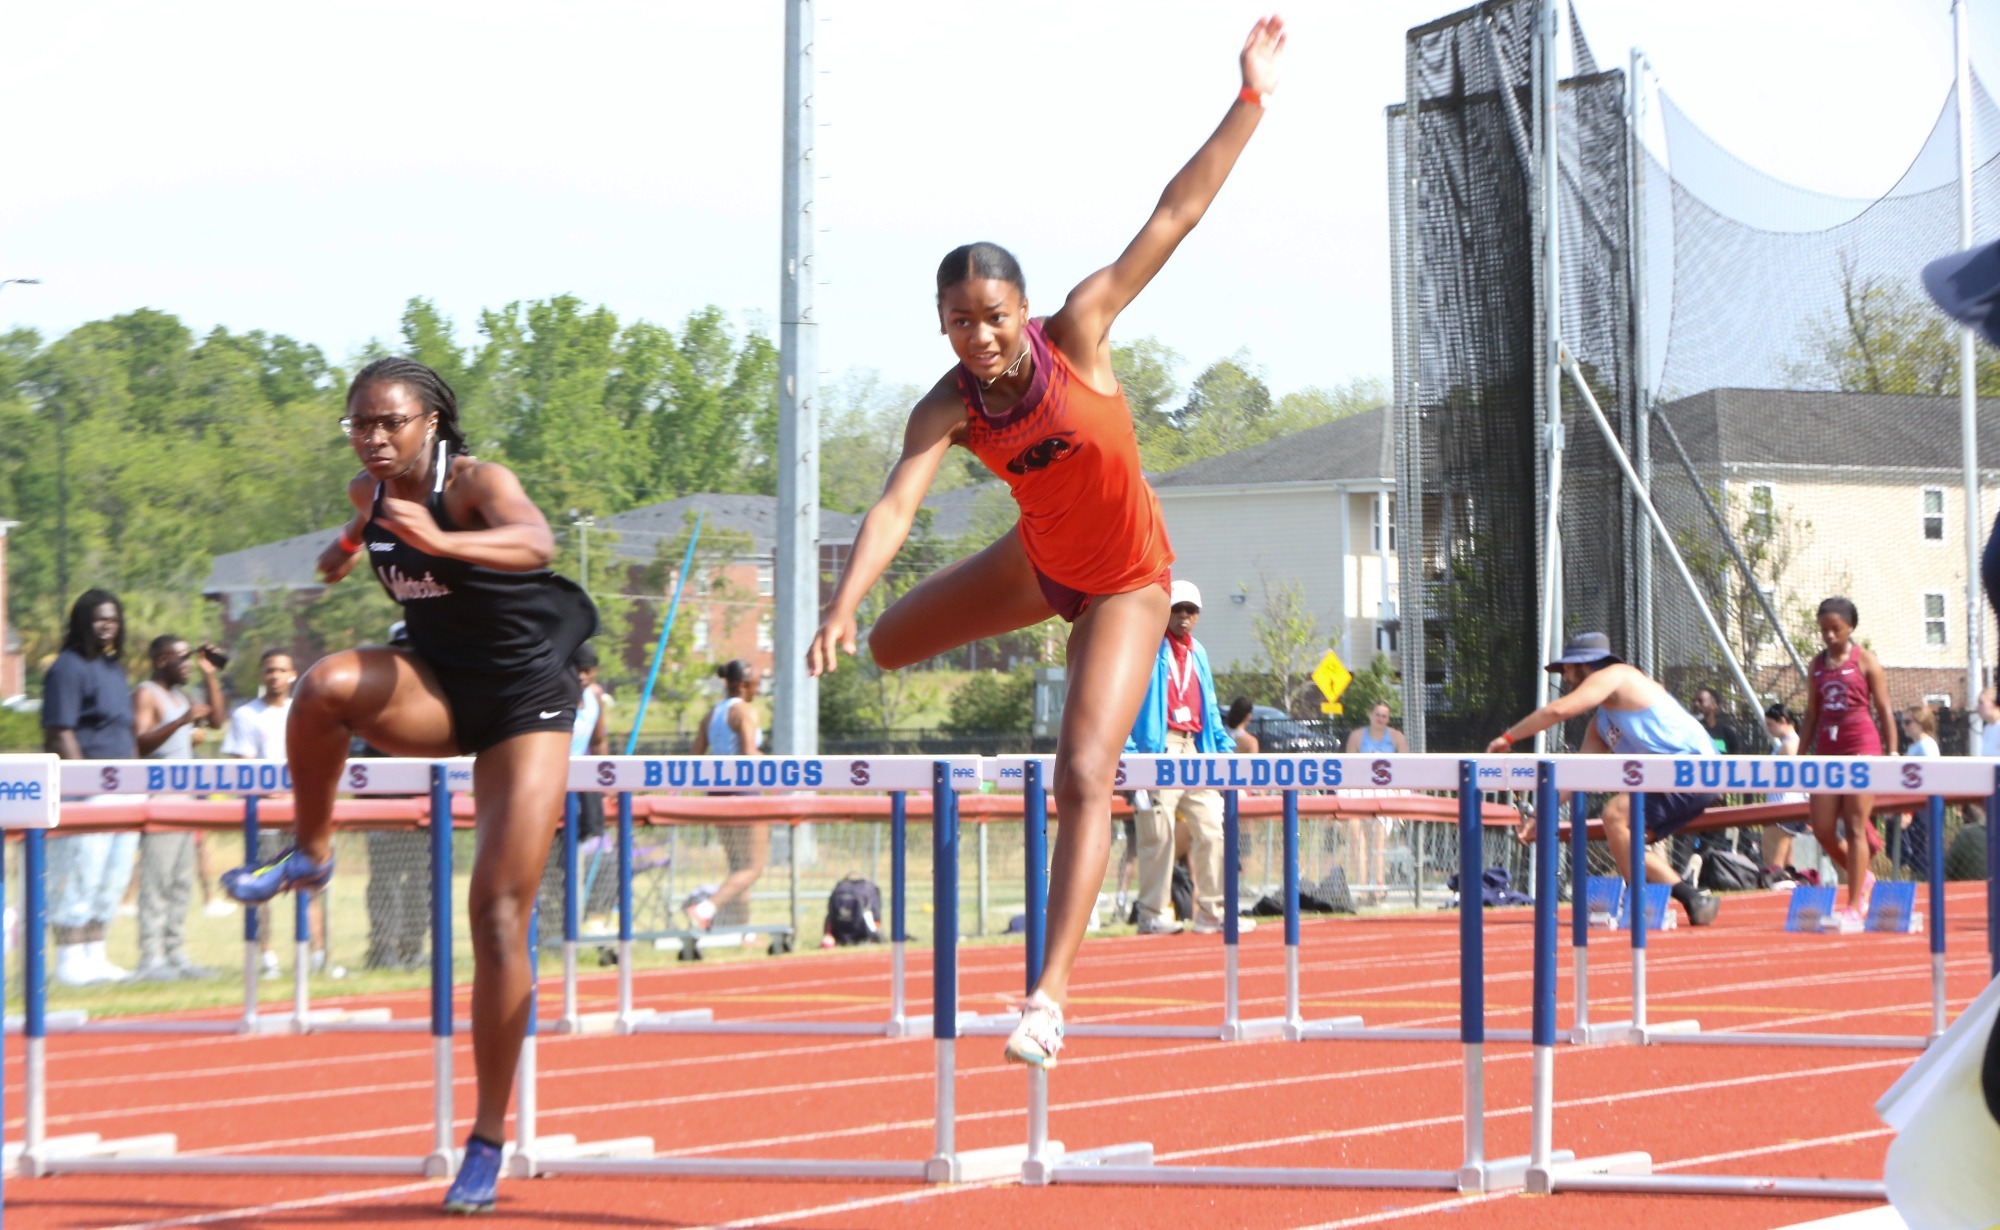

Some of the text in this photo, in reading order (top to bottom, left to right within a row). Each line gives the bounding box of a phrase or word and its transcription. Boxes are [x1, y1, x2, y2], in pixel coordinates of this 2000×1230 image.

[101, 766, 119, 790] S
[350, 764, 368, 789] S
[597, 760, 870, 787] S BULLDOGS S
[1155, 759, 1342, 786] BULLDOGS
[1371, 759, 1392, 786] S
[1622, 760, 1922, 789] S BULLDOGS S
